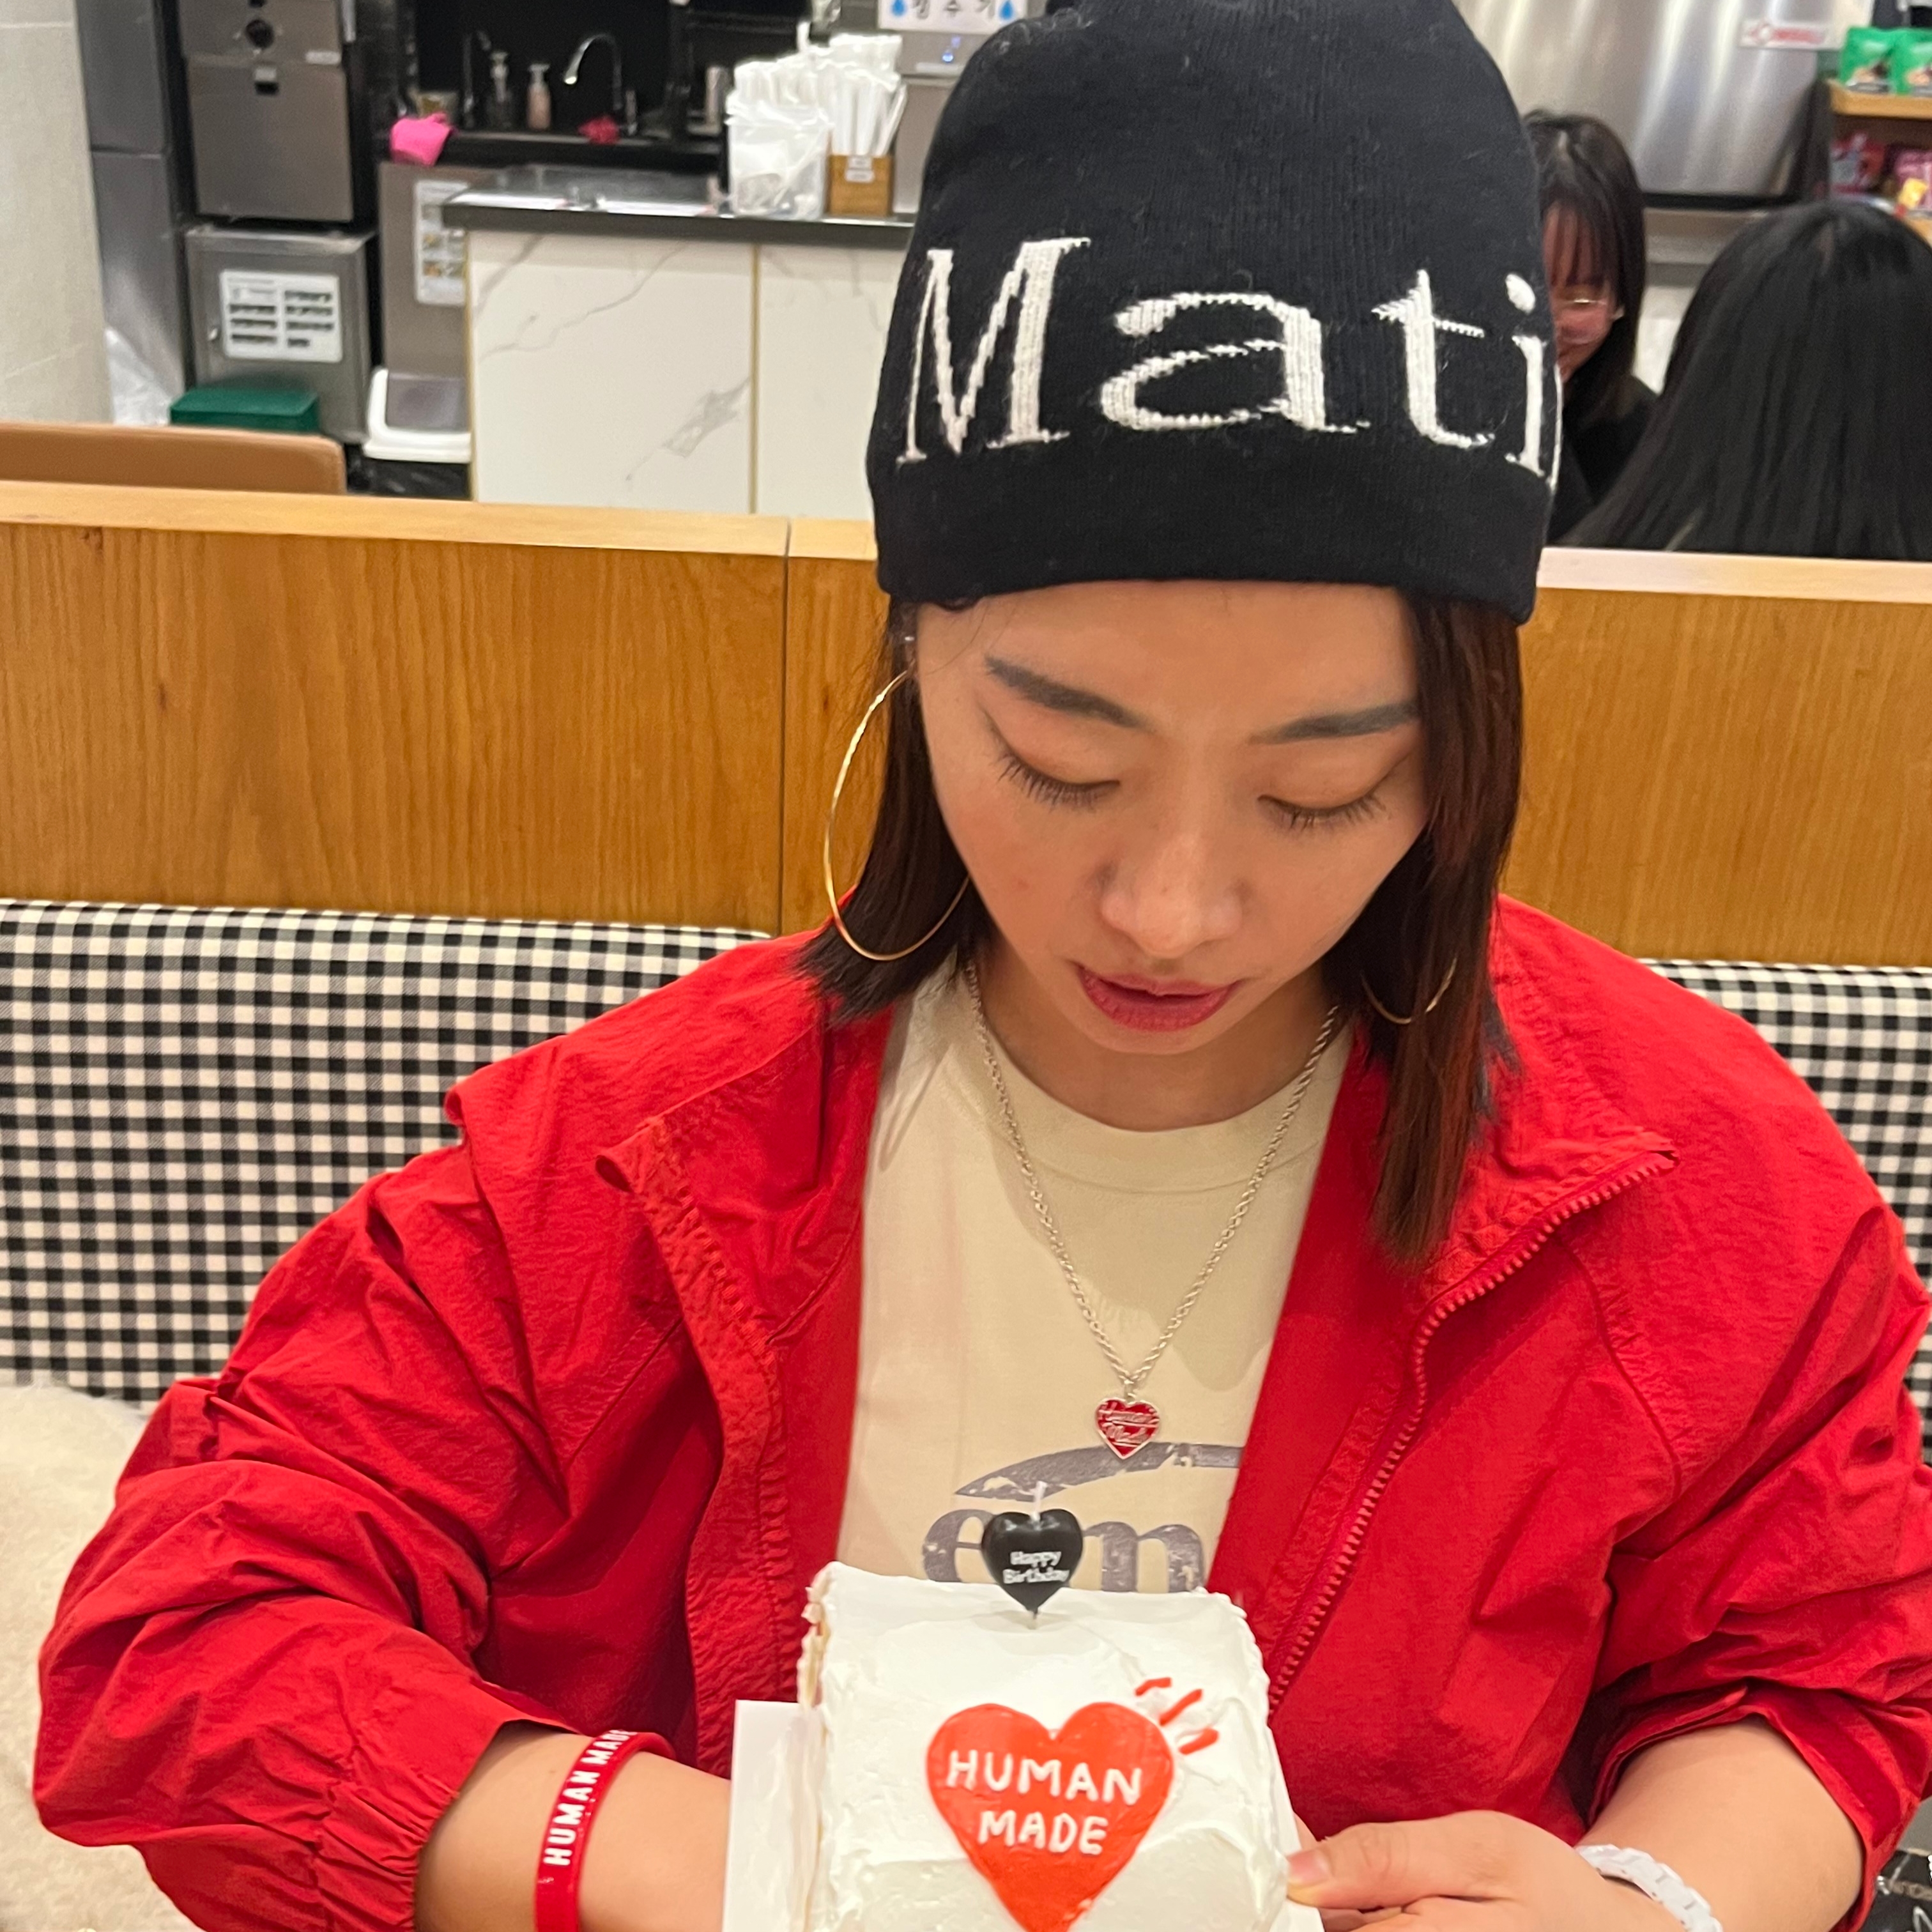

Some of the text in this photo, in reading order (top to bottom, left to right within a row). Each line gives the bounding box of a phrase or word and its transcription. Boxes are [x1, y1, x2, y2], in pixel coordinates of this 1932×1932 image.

[897, 237, 1563, 493] Mati
[1002, 1567, 1070, 1584] Birthday
[1010, 1551, 1061, 1567] Happy
[946, 1749, 1142, 1805] HUMAN
[543, 1770, 601, 1866] HUMAN
[978, 1809, 1108, 1855] MADE
